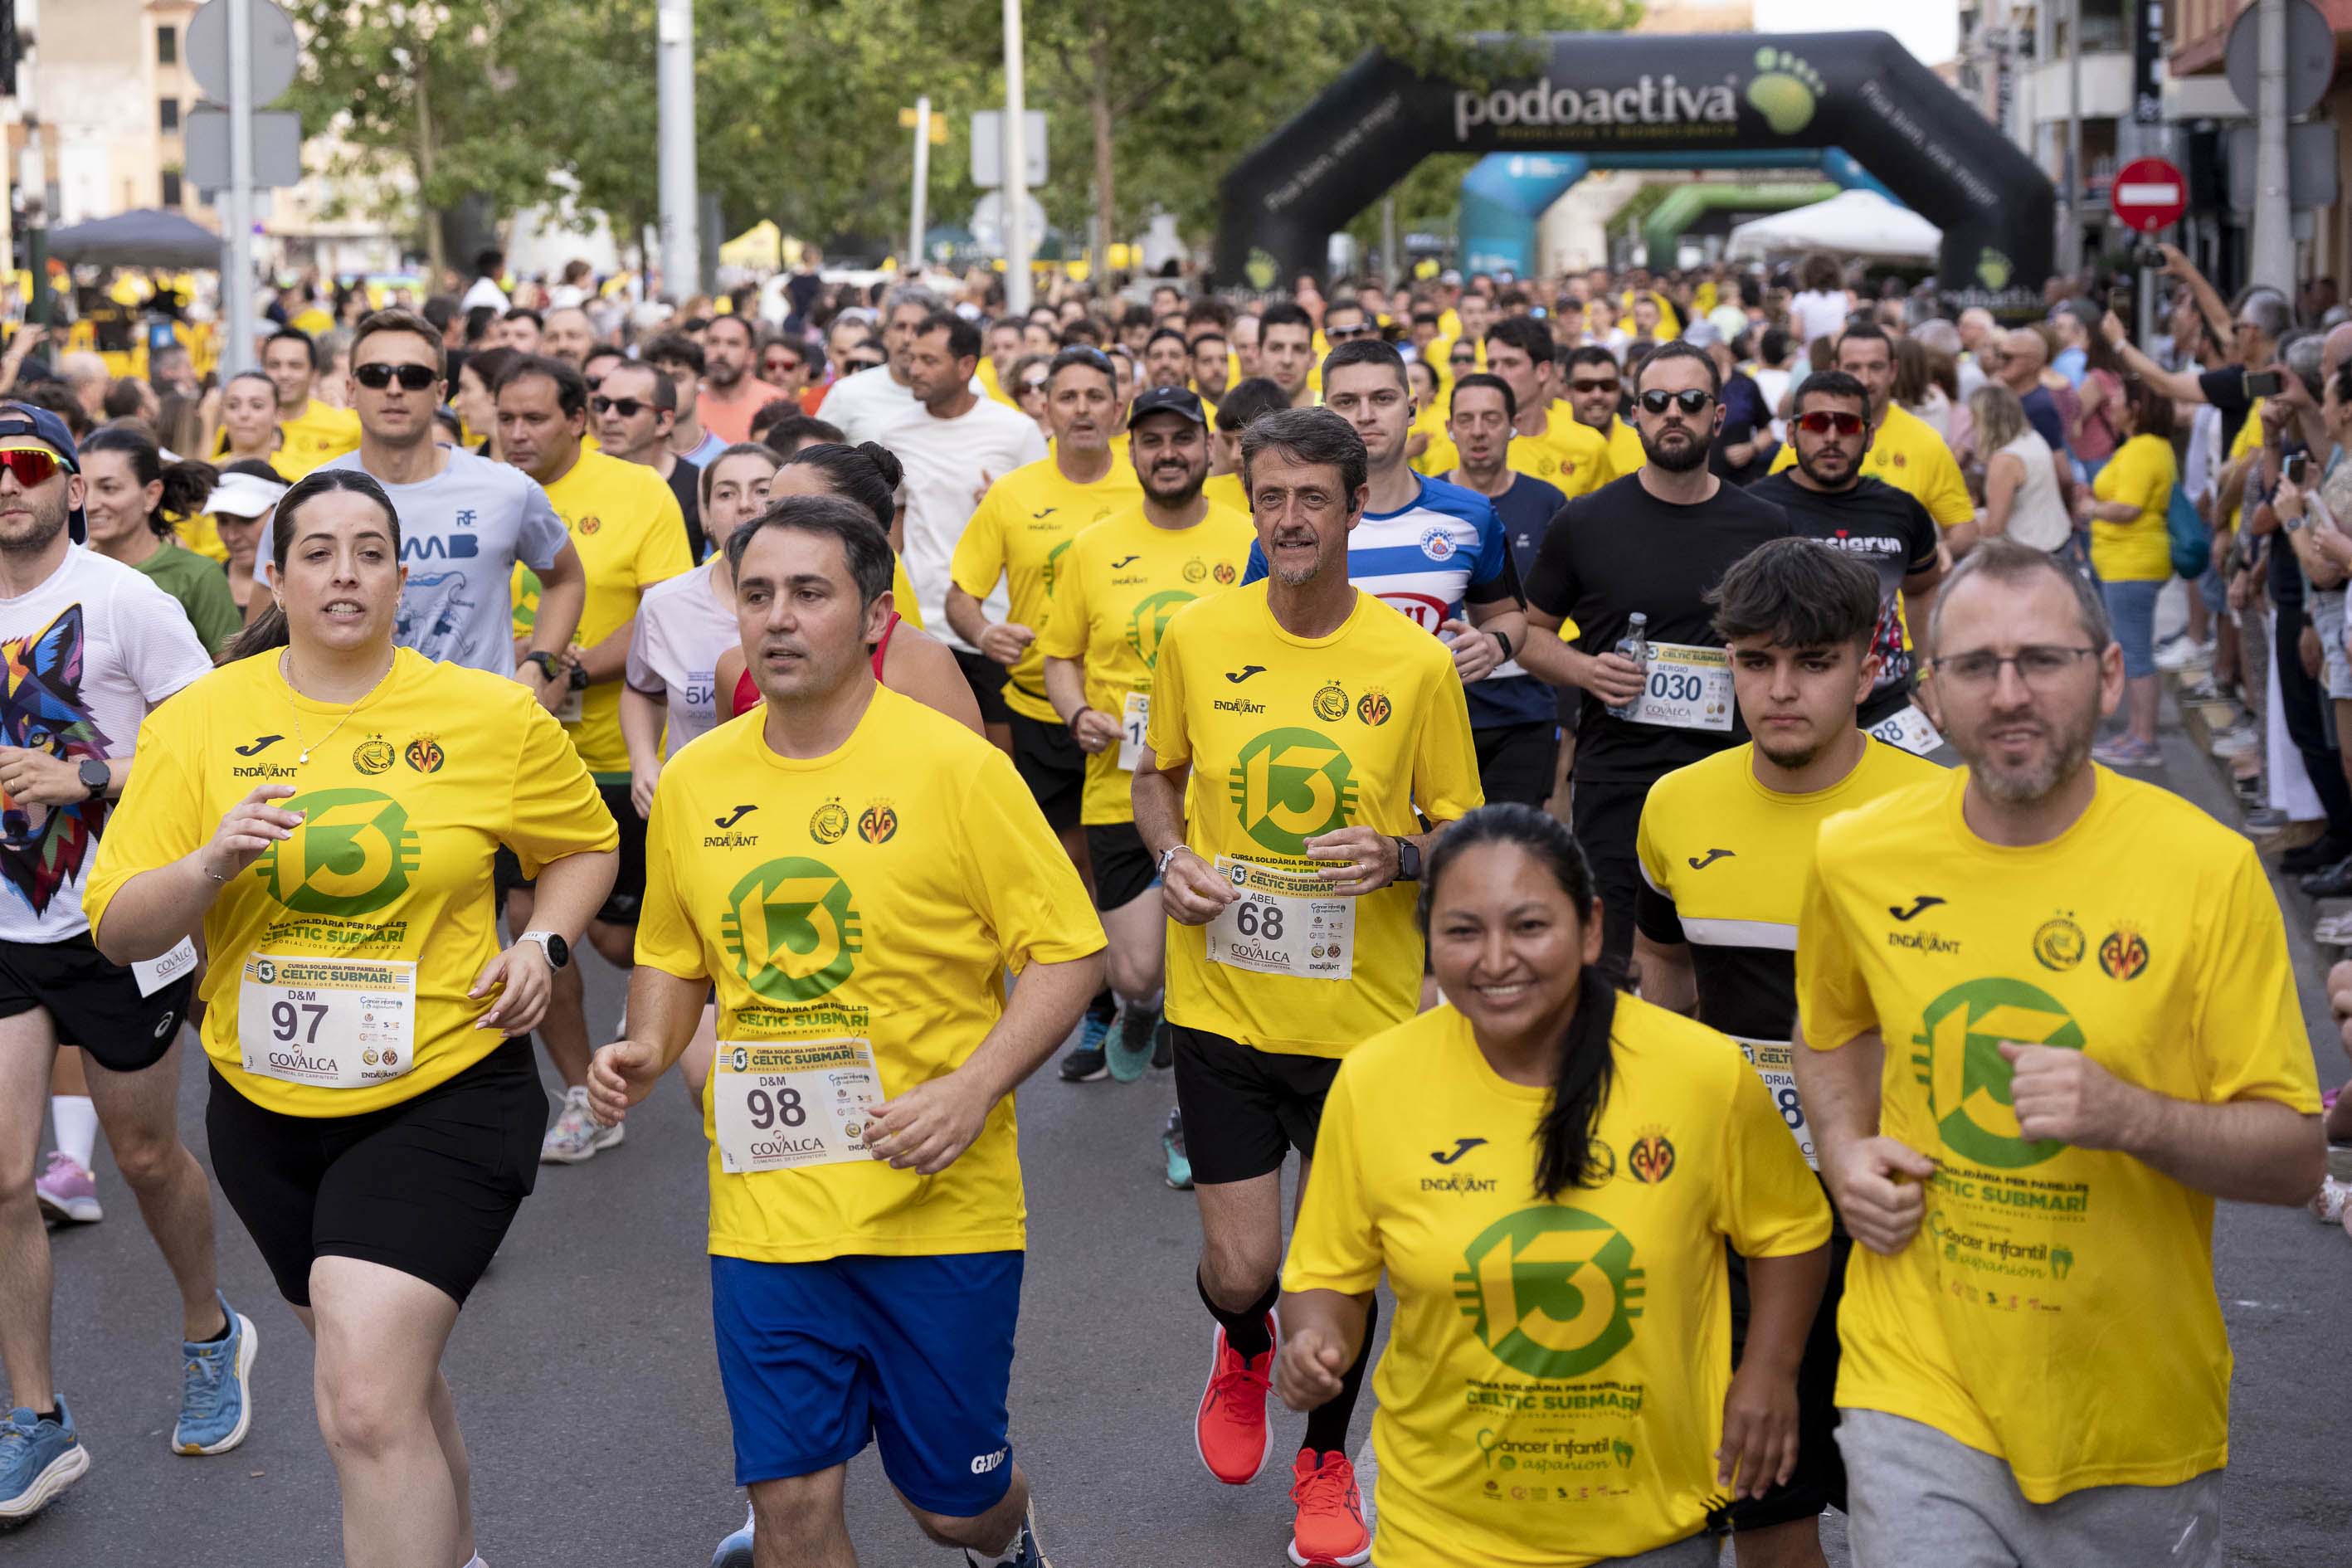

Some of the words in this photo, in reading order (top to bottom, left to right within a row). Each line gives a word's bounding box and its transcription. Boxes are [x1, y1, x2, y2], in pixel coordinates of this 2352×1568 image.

[1454, 73, 1740, 142] podoactiva
[1641, 672, 1702, 701] 030
[1214, 698, 1266, 716] ENDAVANT
[232, 763, 298, 781] ENDAVANT
[704, 832, 759, 851] ENDAVANT
[1231, 853, 1254, 862] CURSA
[1255, 855, 1297, 866] SOLIDÀRIA
[1250, 874, 1284, 889] CELTIC
[1249, 892, 1278, 905] ABEL
[347, 921, 363, 930] PER
[1237, 902, 1283, 940] 68
[326, 926, 405, 944] SUBMARÍ
[1231, 943, 1290, 963] COVALCA
[281, 969, 329, 981] CELTIC
[330, 971, 393, 984] SUBMARÍ
[288, 990, 316, 1001] D&M
[271, 1001, 329, 1044] 97
[737, 1012, 789, 1028] CELTIC
[269, 1052, 338, 1071] COVALCA
[752, 1054, 791, 1066] CELTIC
[795, 1048, 855, 1064] SUBMARÍ
[760, 1076, 786, 1086] D&M
[747, 1088, 806, 1129] 98
[751, 1137, 825, 1156] COVALCA
[1988, 1237, 2048, 1261] infantil
[1553, 1438, 1609, 1459] infantil
